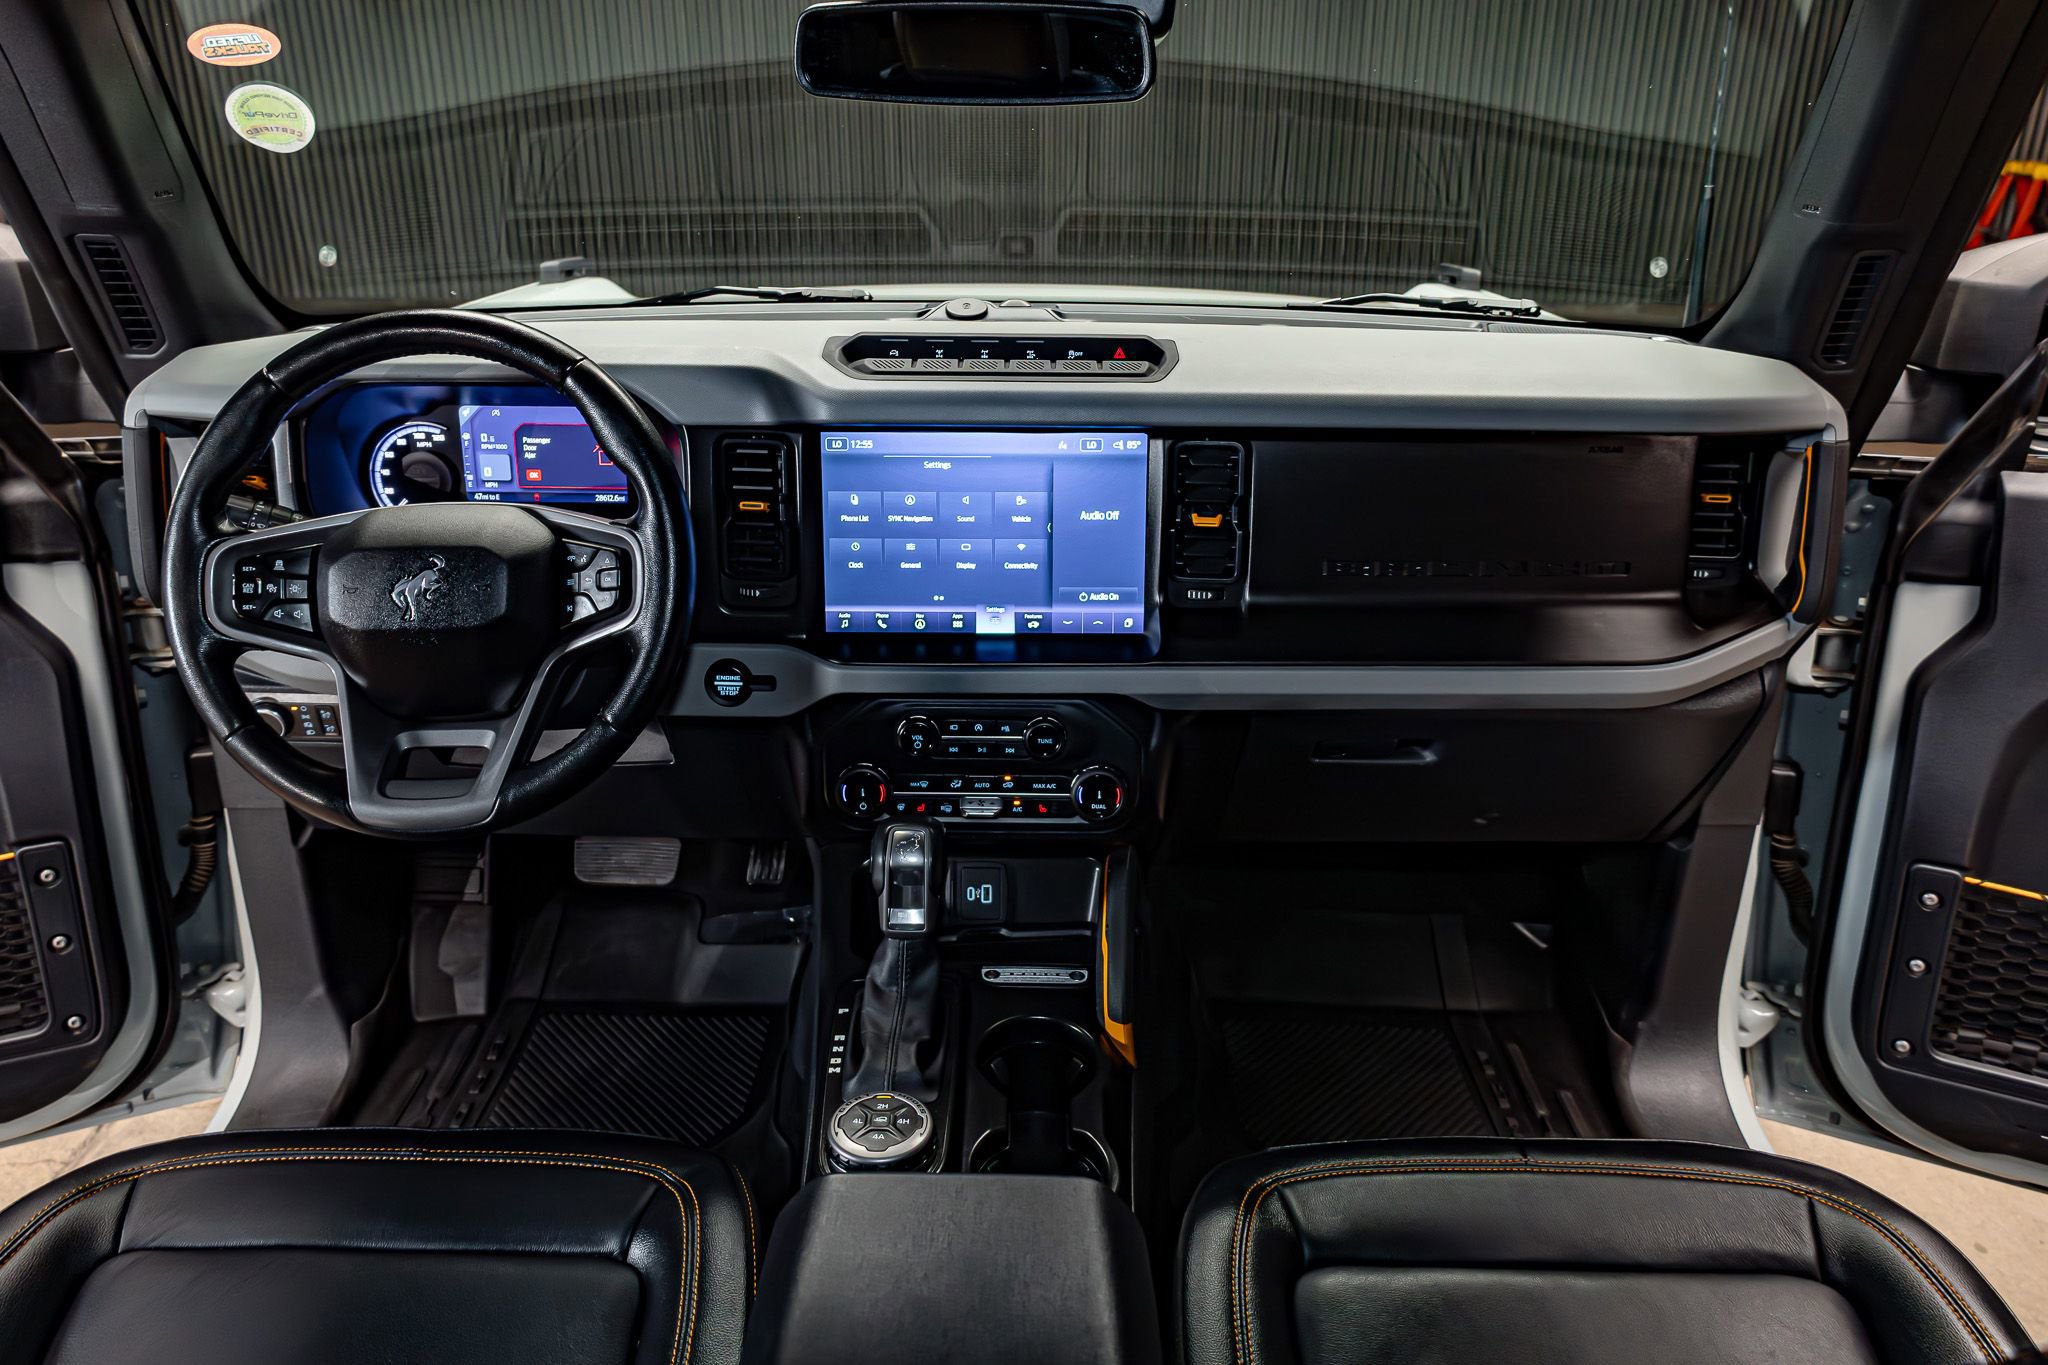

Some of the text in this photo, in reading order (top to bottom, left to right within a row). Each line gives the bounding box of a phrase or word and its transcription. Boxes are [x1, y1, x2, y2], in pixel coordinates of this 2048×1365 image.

[832, 440, 842, 448] LO
[850, 440, 873, 449] 12:55
[1087, 441, 1097, 449] LO
[923, 461, 951, 470] Settings
[904, 515, 933, 523] Navigation
[1080, 510, 1119, 521] Audio Off
[956, 562, 976, 570] Display
[1004, 562, 1038, 570] Connectivity
[1089, 592, 1119, 601] Audio On
